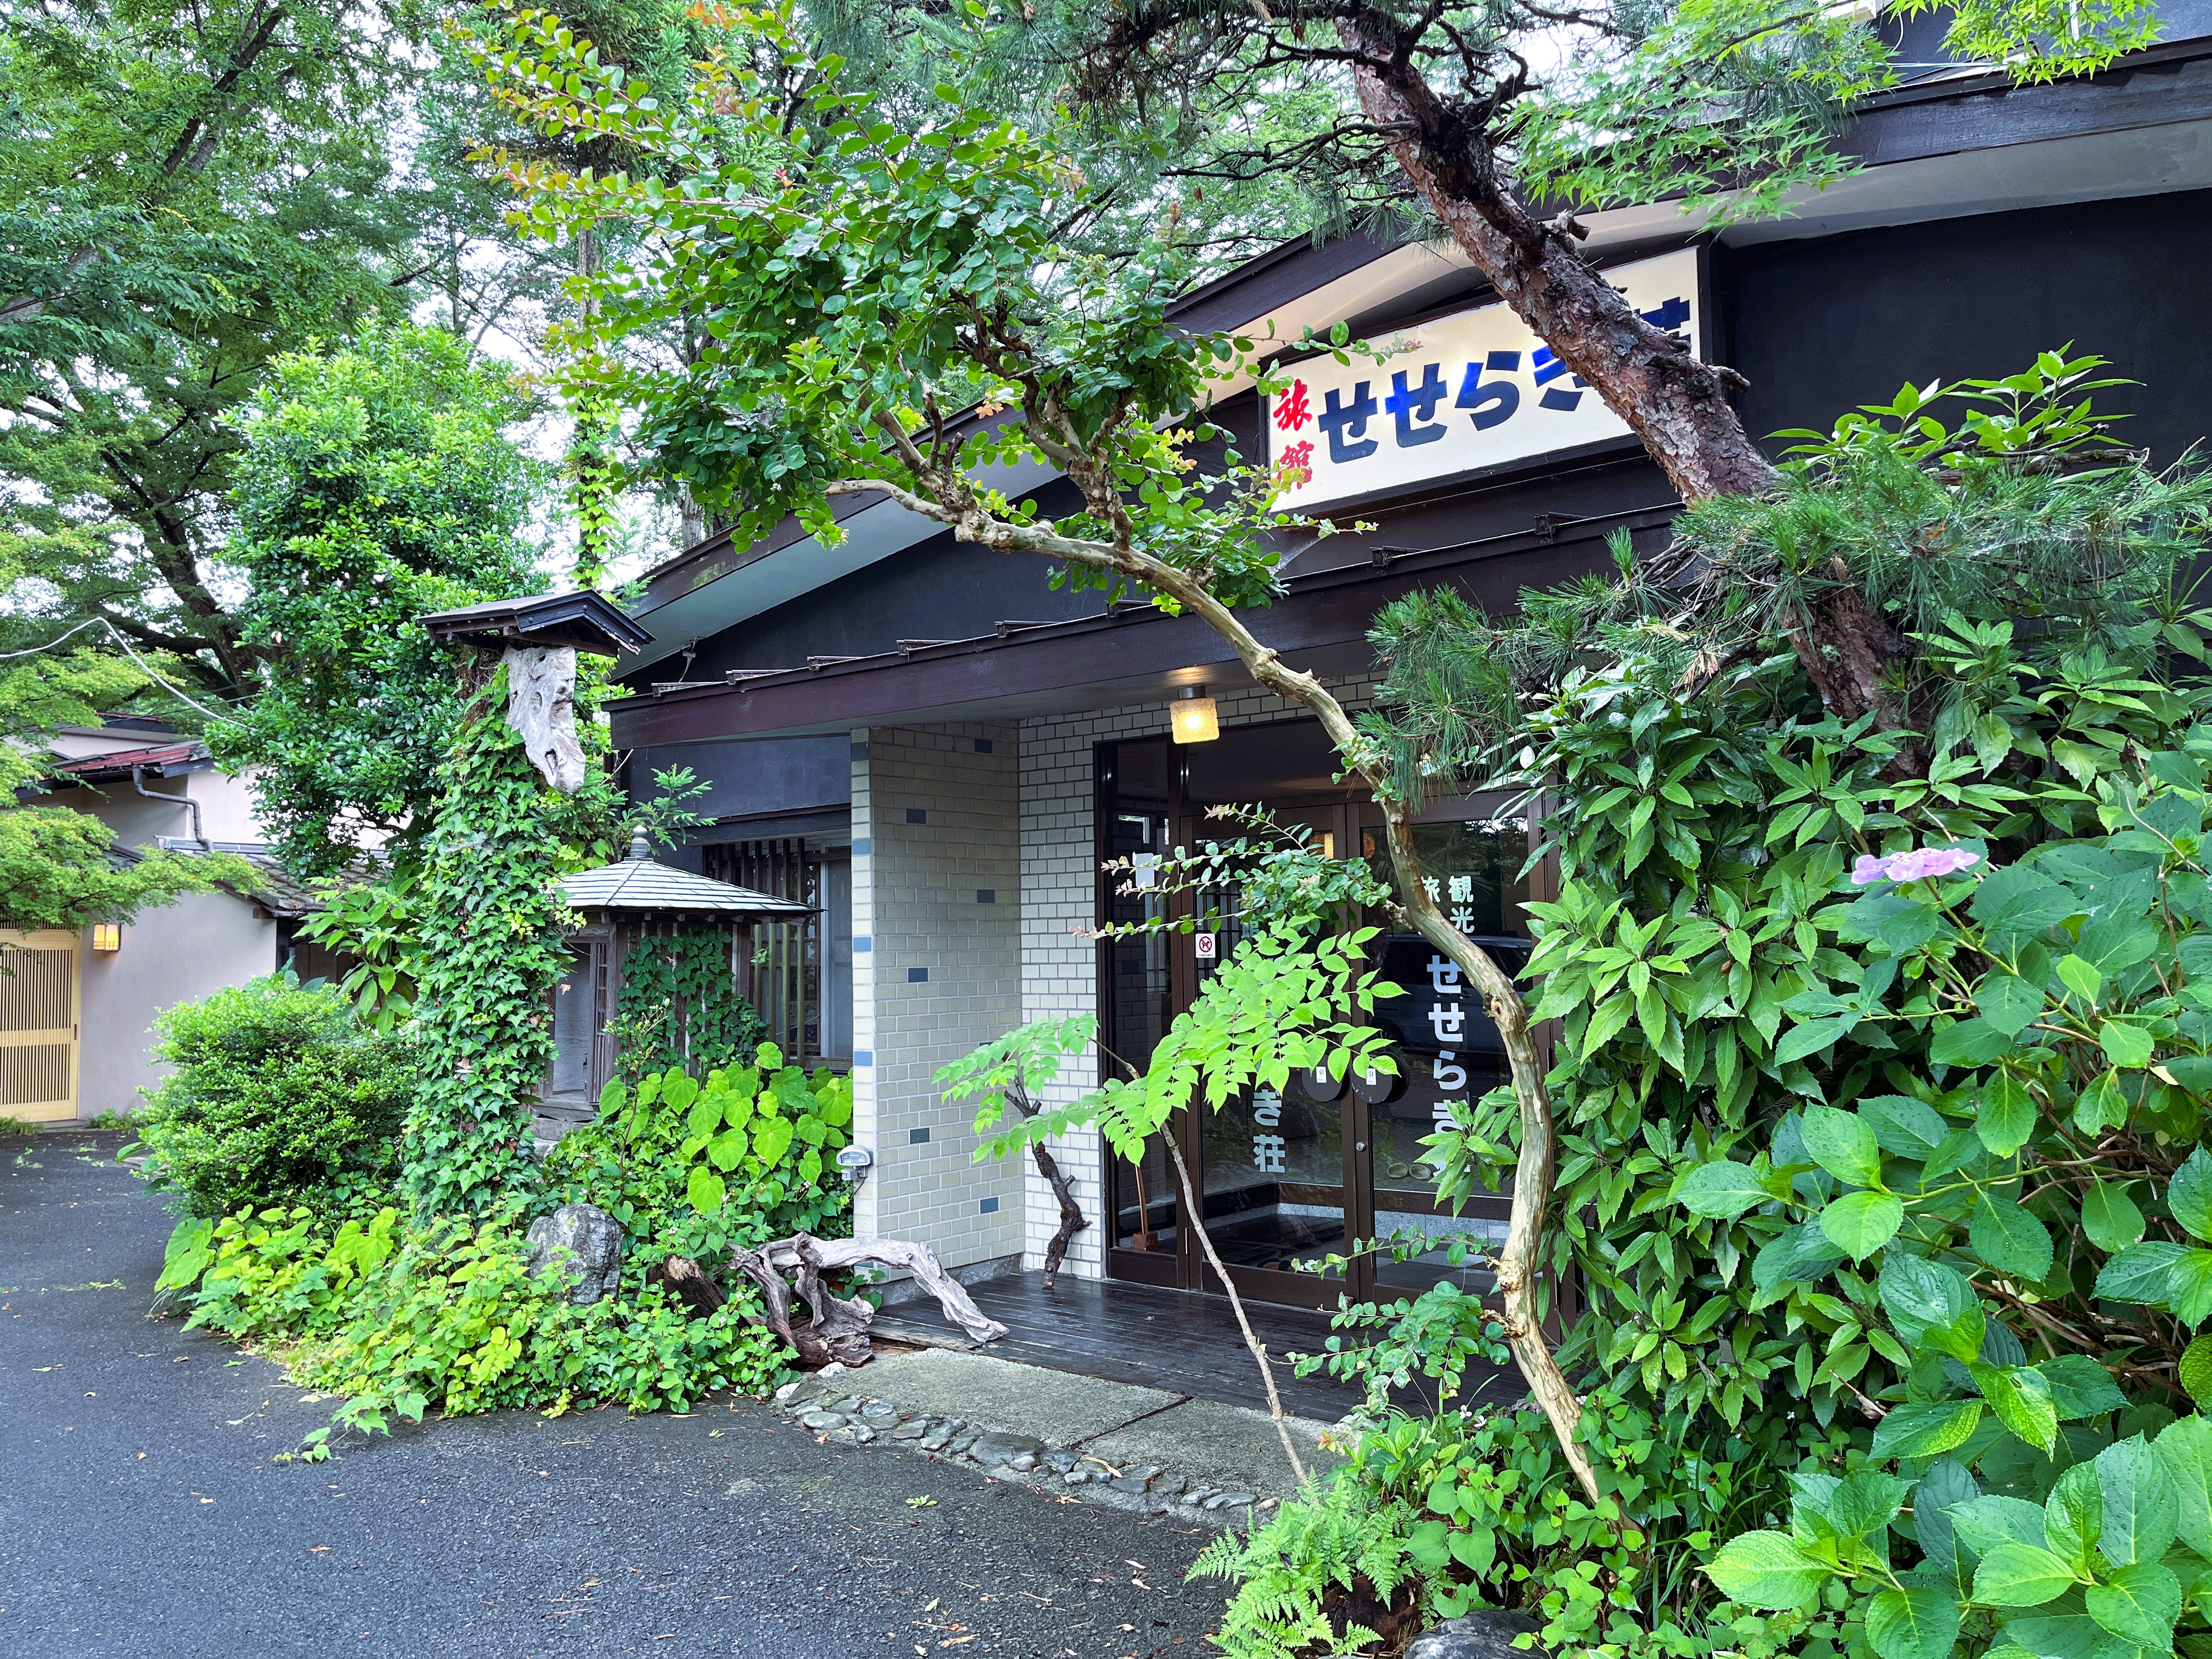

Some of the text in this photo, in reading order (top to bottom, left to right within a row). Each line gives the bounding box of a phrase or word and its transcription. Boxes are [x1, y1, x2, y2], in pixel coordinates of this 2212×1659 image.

[1448, 876, 1475, 933] 観光
[1427, 955, 1470, 1177] せせらぎ
